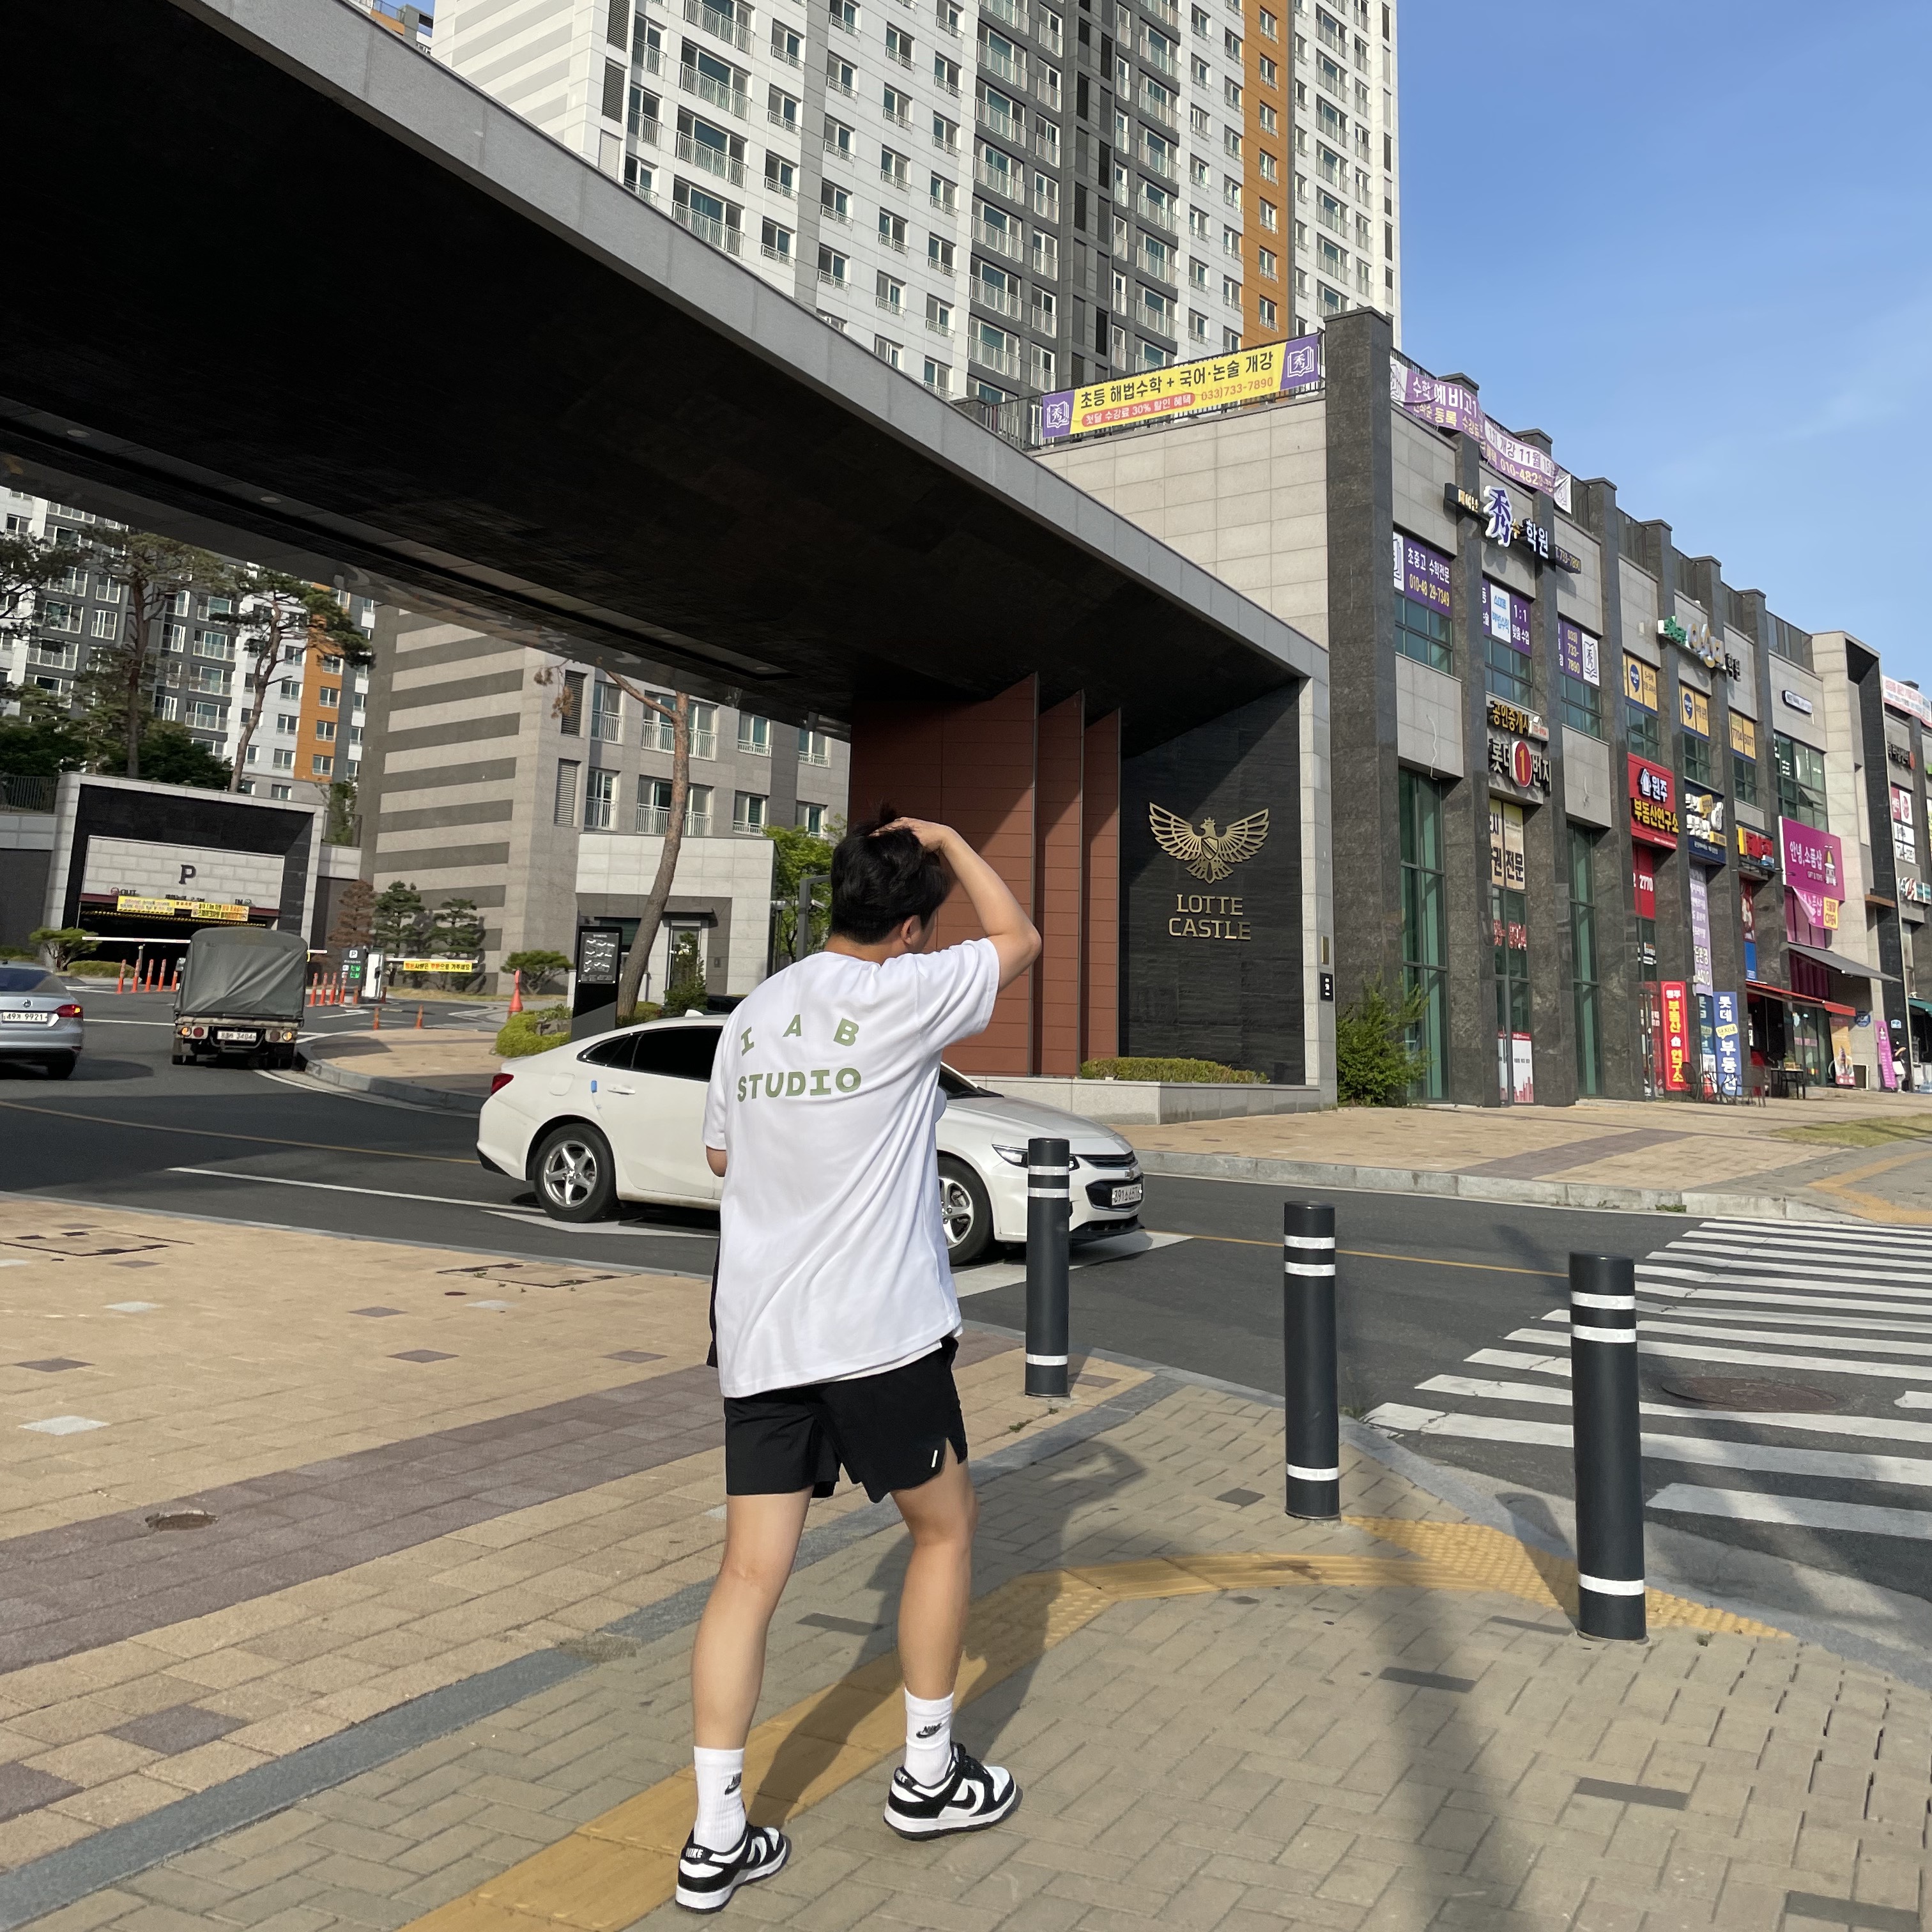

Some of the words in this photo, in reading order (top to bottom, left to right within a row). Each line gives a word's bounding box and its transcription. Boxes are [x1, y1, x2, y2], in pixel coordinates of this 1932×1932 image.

[1081, 388, 1105, 409] 초등
[1110, 376, 1162, 402] 해법수학
[1167, 378, 1174, 387] +
[1180, 360, 1239, 387] 국어·논술
[1246, 351, 1273, 373] 개강
[1201, 376, 1273, 401] 033)733-7890
[1085, 413, 1102, 425] 첫달
[1105, 408, 1130, 421] 수강료
[1131, 403, 1151, 416] 30%
[1154, 398, 1170, 411] 할인
[1174, 394, 1192, 406] 혜택
[1434, 383, 1477, 418] 예비고1
[1500, 436, 1516, 458] 개강
[1435, 407, 1457, 427] 등록
[1526, 519, 1549, 559] 학원
[1407, 547, 1426, 571] 초중고
[1429, 559, 1450, 584] 수학전문
[1514, 604, 1527, 623] 1:1
[1492, 700, 1529, 734] 공인중개사
[1652, 776, 1667, 802] 원주
[180, 864, 196, 885] P
[1505, 850, 1523, 882] 전문
[1176, 894, 1243, 916] LOTTE
[1169, 917, 1251, 940] CASTLE
[737, 1068, 862, 1103] STUDIO
[685, 1847, 704, 1859] NIKE
